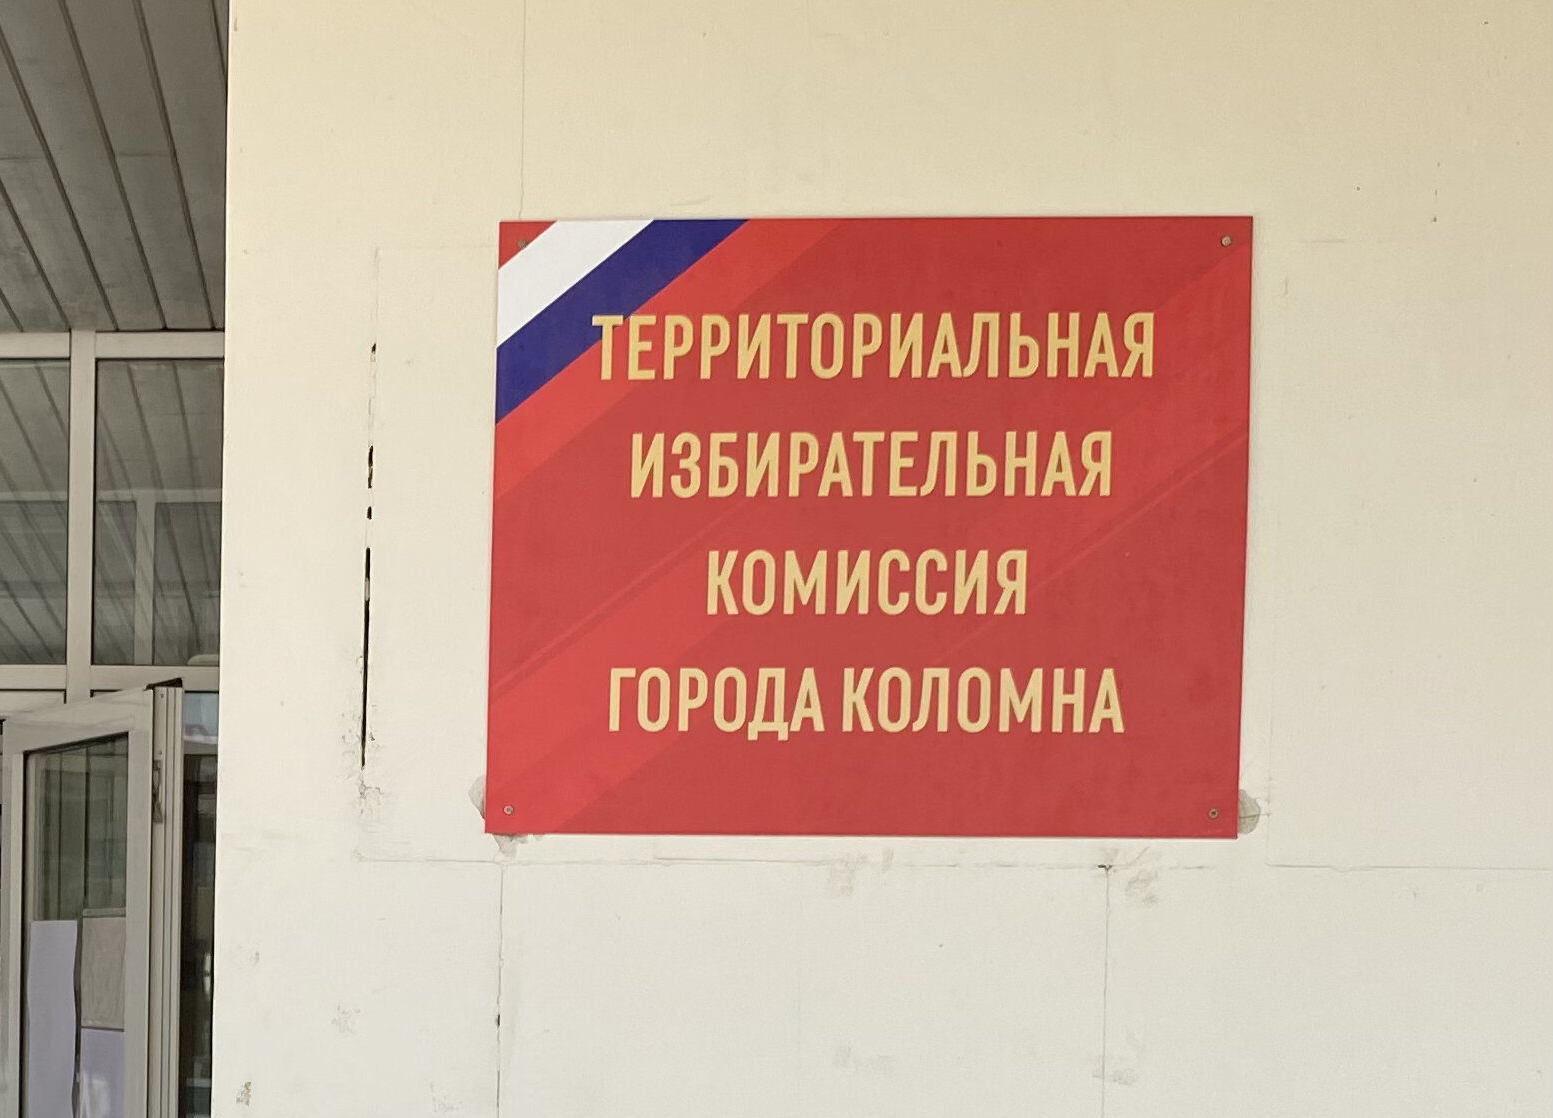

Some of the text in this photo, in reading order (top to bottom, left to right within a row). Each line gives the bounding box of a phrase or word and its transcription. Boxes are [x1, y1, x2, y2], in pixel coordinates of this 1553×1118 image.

[592, 312, 1154, 381] ТЕРРИТОРИАЛЬНАЯ
[630, 430, 1112, 499] ИЗБИРАТЕЛЬНАЯ
[706, 549, 1028, 616] КОМИССИЯ
[607, 667, 1125, 741] ГОРОДА КОЛОМНА
